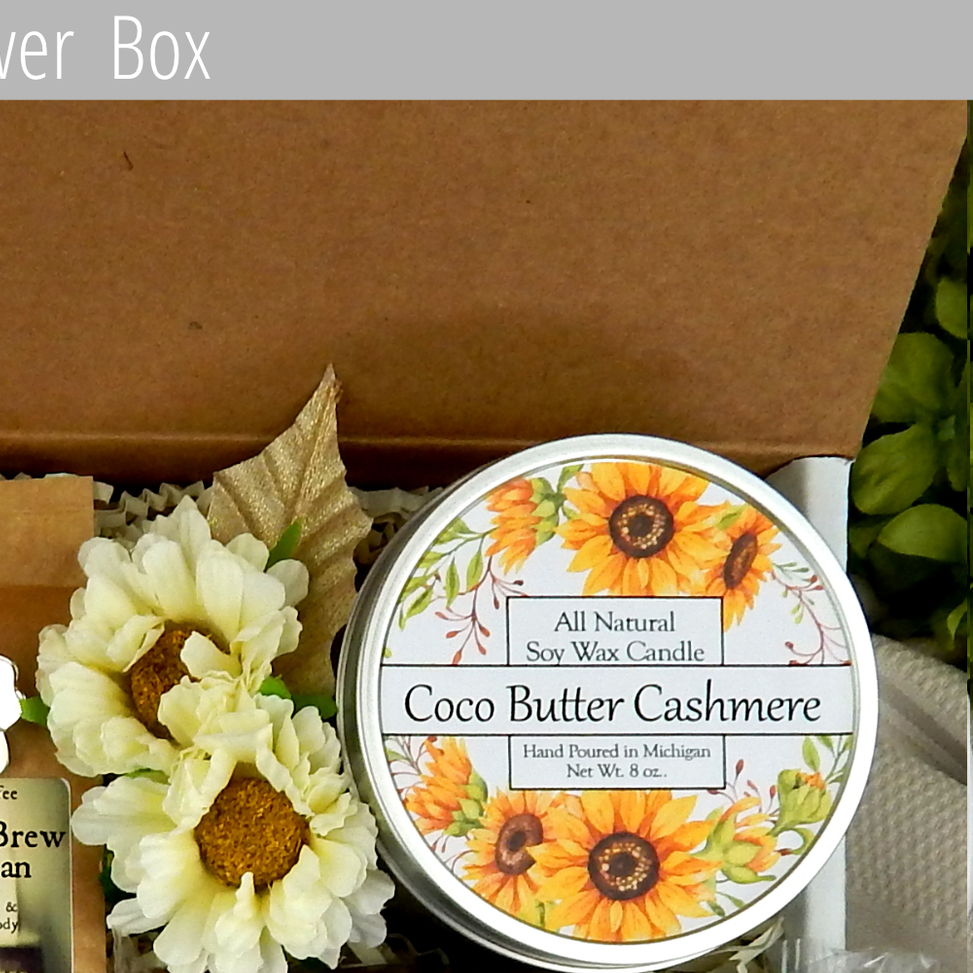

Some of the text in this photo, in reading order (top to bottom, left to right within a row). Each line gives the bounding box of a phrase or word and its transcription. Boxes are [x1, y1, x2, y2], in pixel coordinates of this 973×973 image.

[553, 610, 675, 633] All Natural
[525, 639, 706, 665] Soy Wax Candle
[404, 678, 821, 723] Coco Butter Cashmere
[523, 743, 711, 762] Hand Poured in Michigan
[566, 763, 593, 778] Net
[597, 763, 625, 778] Wt.
[629, 763, 640, 778] 8
[5, 901, 18, 913] &
